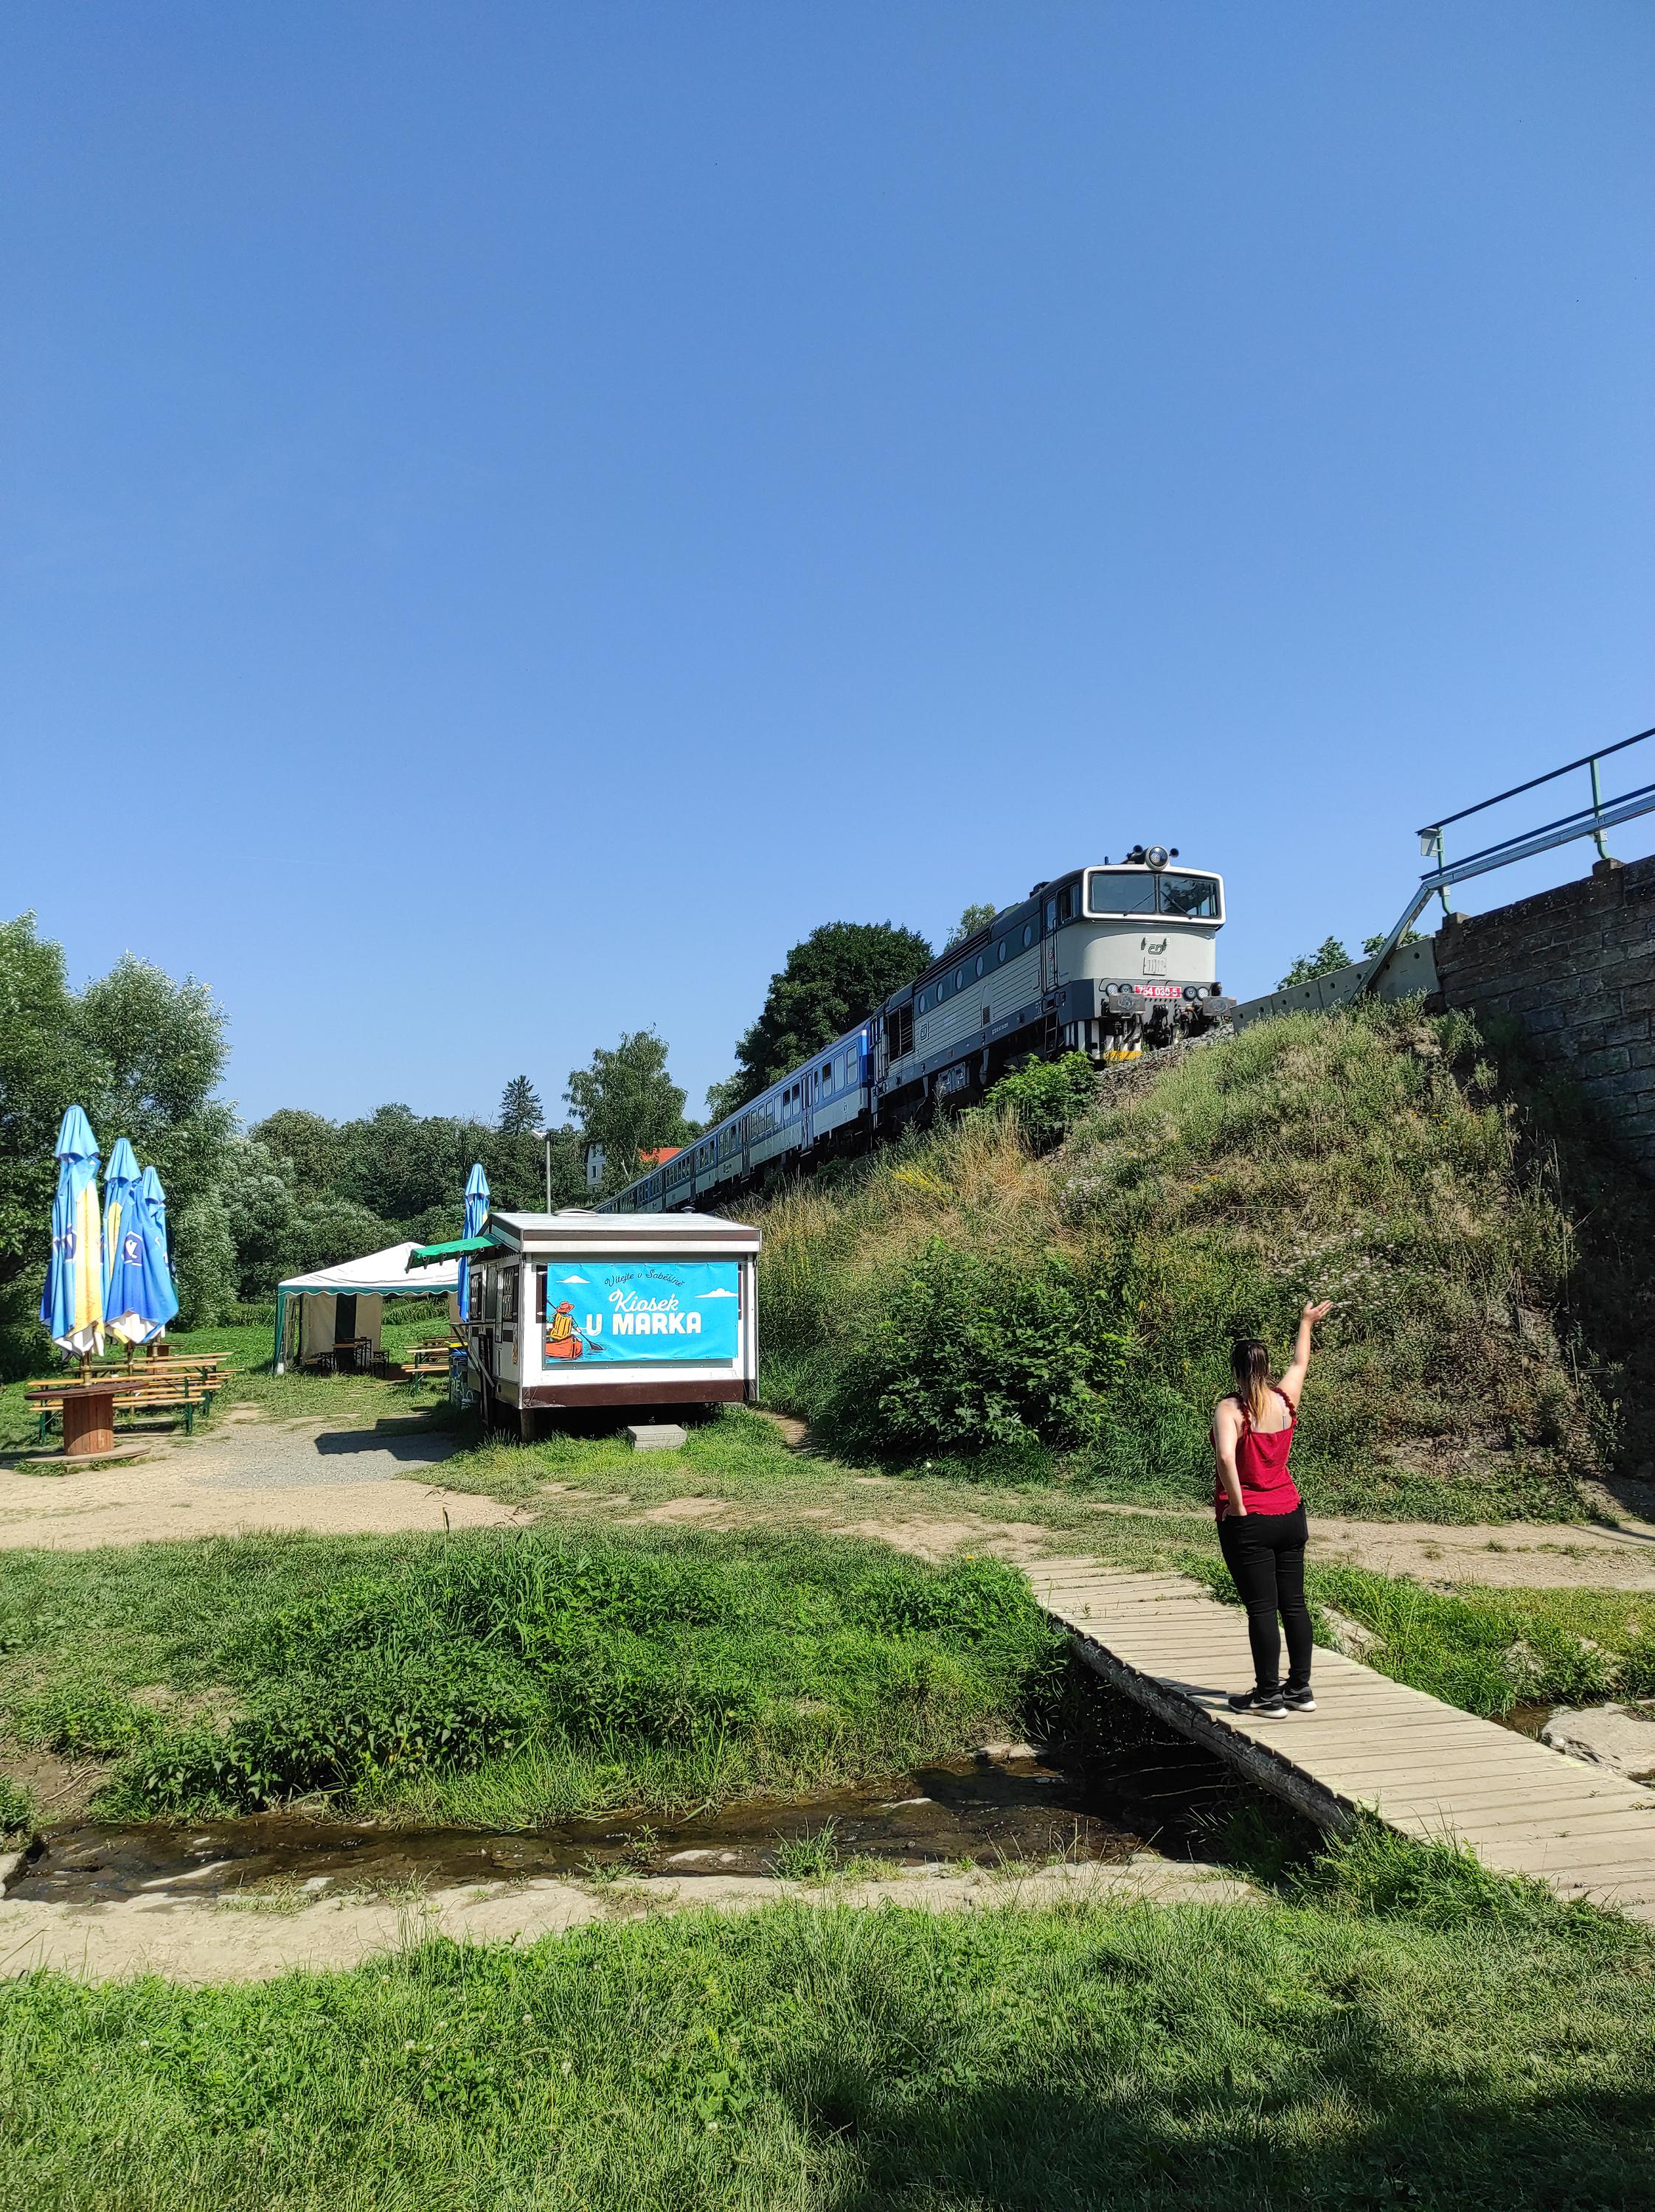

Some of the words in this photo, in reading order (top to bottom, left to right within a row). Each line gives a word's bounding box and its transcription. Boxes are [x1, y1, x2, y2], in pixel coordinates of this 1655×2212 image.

[608, 1287, 679, 1312] Kiosek
[586, 1313, 603, 1337] U
[612, 1311, 701, 1335] MARKA
